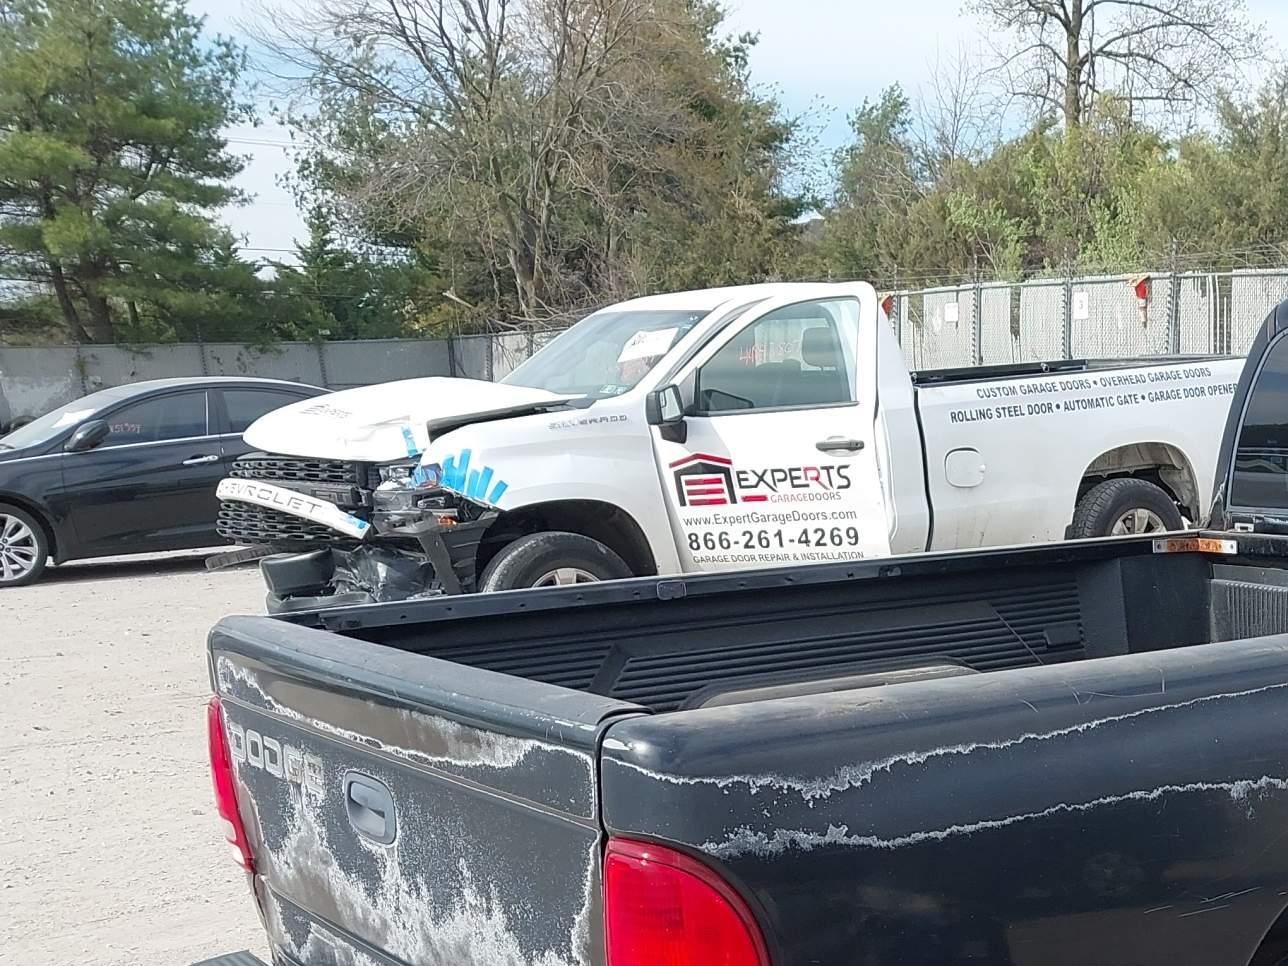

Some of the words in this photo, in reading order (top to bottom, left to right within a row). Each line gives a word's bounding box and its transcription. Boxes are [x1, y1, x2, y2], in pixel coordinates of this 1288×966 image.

[976, 385, 1018, 400] CUSTOM
[1019, 382, 1059, 396] GARAGE
[1059, 379, 1092, 392] DOORS
[1100, 373, 1147, 388] OVERHEAD
[1148, 370, 1182, 384] GARAGE
[1183, 367, 1212, 379] DOORS
[950, 406, 994, 424] ROLLING
[995, 404, 1026, 419] STEEL
[1027, 402, 1055, 416] DOOR
[1063, 395, 1115, 413] AUTOMATIC
[1117, 393, 1140, 407] GATE
[1148, 389, 1182, 402] GARAGE
[1183, 385, 1207, 398] DOOR
[735, 464, 851, 492] EXPERTS
[770, 491, 842, 503] GARAGEDOORS
[683, 509, 858, 527] www.ExpertGarageDoors.com
[688, 527, 860, 551] 866-261-4269
[693, 555, 731, 564] GARAGE
[731, 554, 758, 563] DOOR
[758, 553, 792, 562] REPAIR
[792, 552, 799, 561] &
[801, 551, 865, 561] INSTALLATION
[230, 723, 324, 797] DODGE
